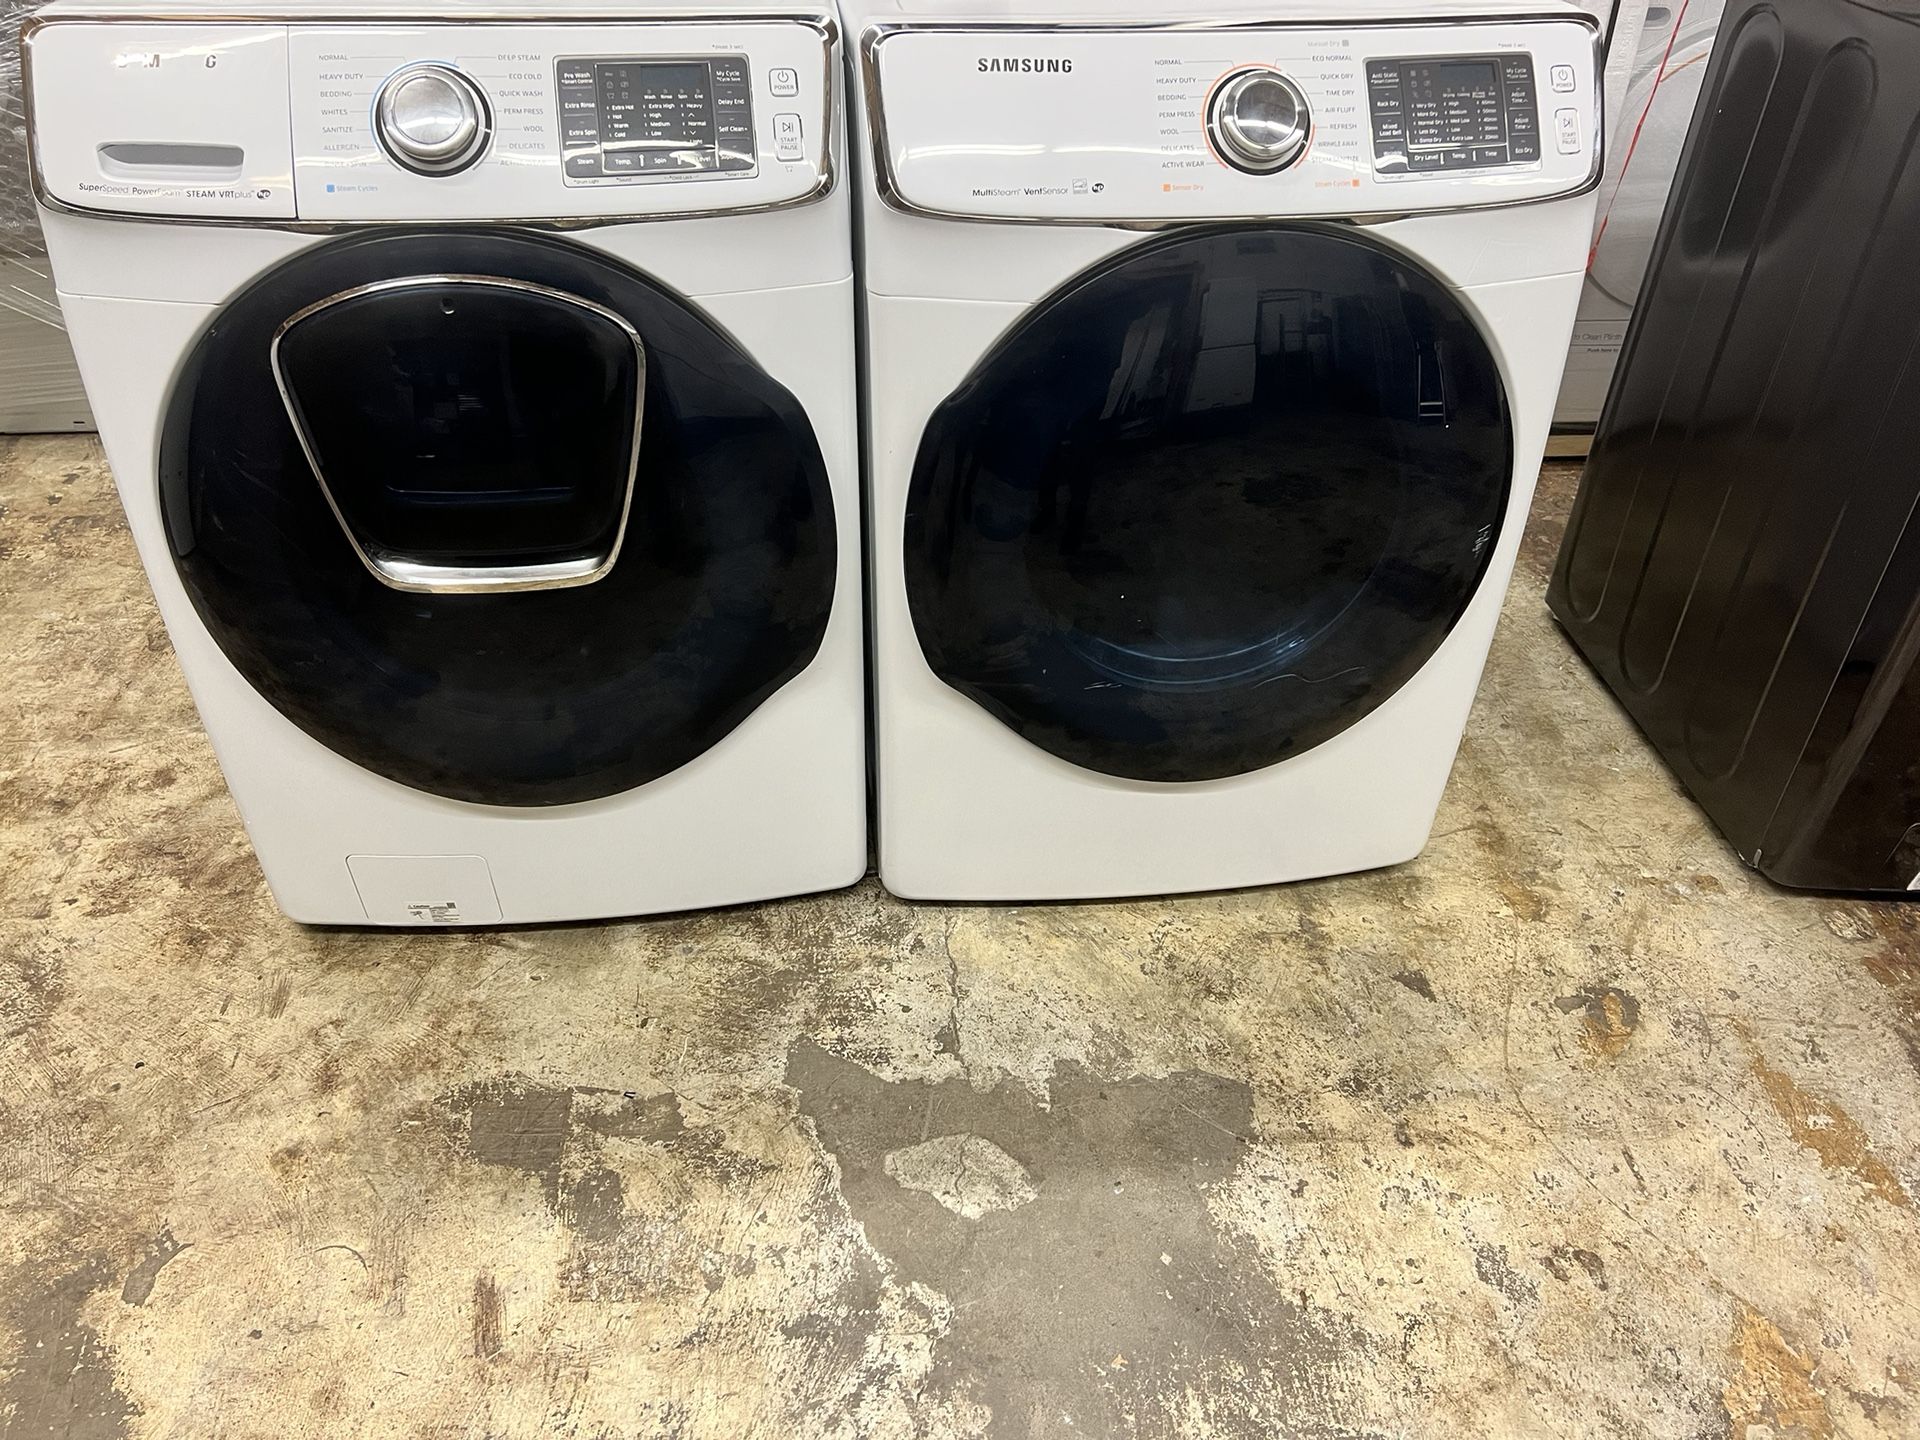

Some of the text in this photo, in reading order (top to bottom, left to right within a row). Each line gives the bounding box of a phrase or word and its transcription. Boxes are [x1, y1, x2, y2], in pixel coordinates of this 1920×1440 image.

[978, 58, 1072, 72] SAMSUNG
[79, 183, 128, 194] SuperSpeed
[187, 190, 216, 198] STEAM
